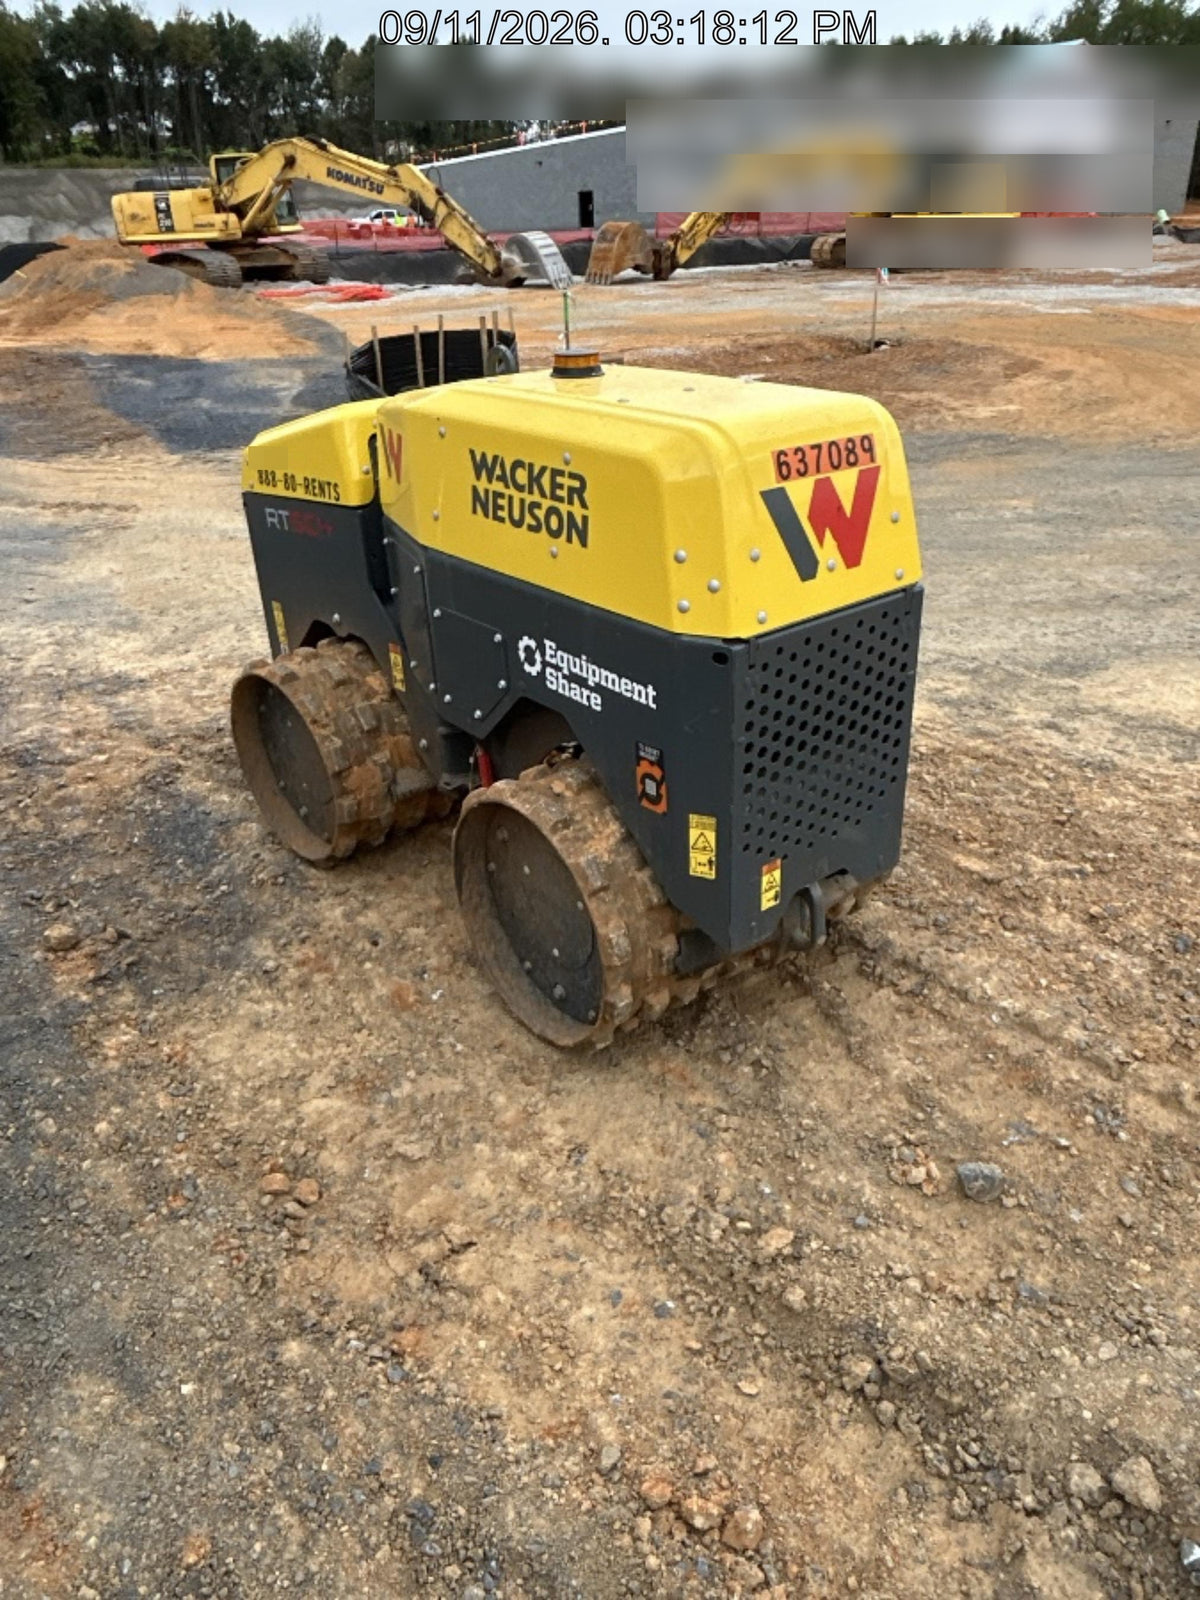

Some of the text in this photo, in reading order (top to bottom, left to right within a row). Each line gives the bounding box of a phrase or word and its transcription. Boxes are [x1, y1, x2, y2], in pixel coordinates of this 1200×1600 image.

[326, 166, 385, 195] KOMATSU
[469, 448, 589, 511] WACKER
[776, 435, 875, 481] 637089
[471, 484, 589, 549] NEUSON
[543, 638, 657, 710] Equipment
[545, 666, 602, 712] Share
